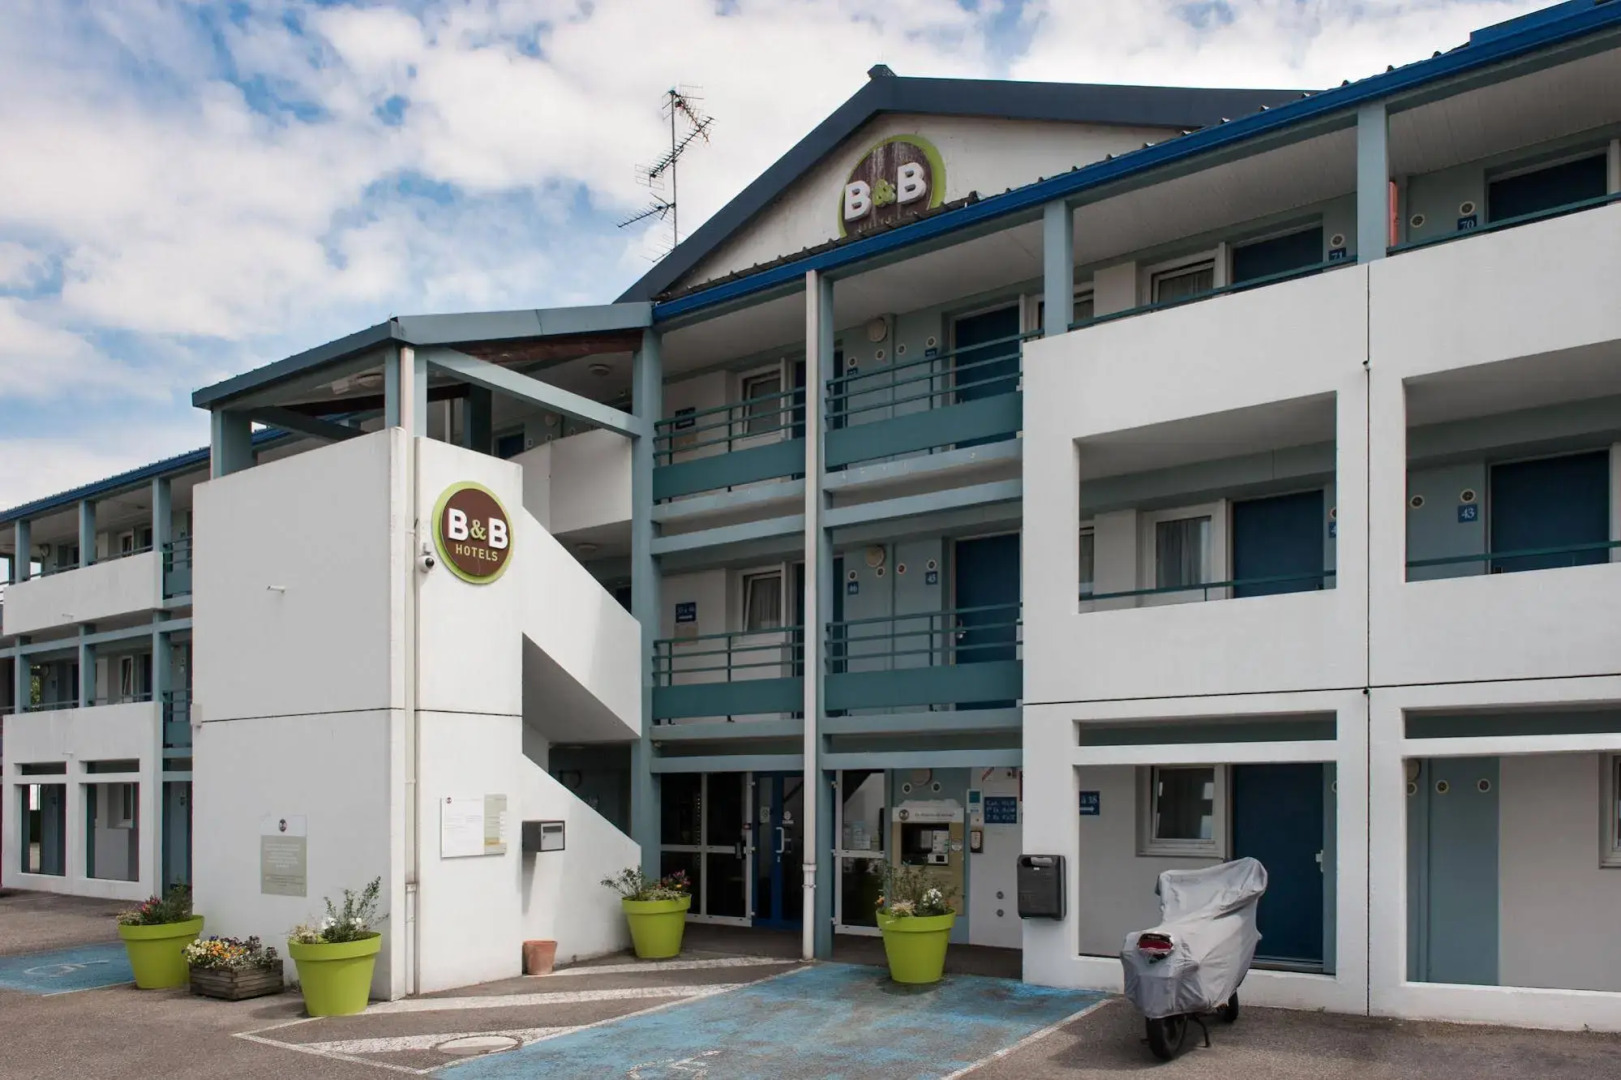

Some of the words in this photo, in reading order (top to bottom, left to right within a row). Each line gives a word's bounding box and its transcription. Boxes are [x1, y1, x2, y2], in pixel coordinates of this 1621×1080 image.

[844, 162, 927, 221] B&B
[1461, 506, 1475, 519] 43
[447, 507, 509, 551] B&B
[455, 543, 499, 562] HOTELS
